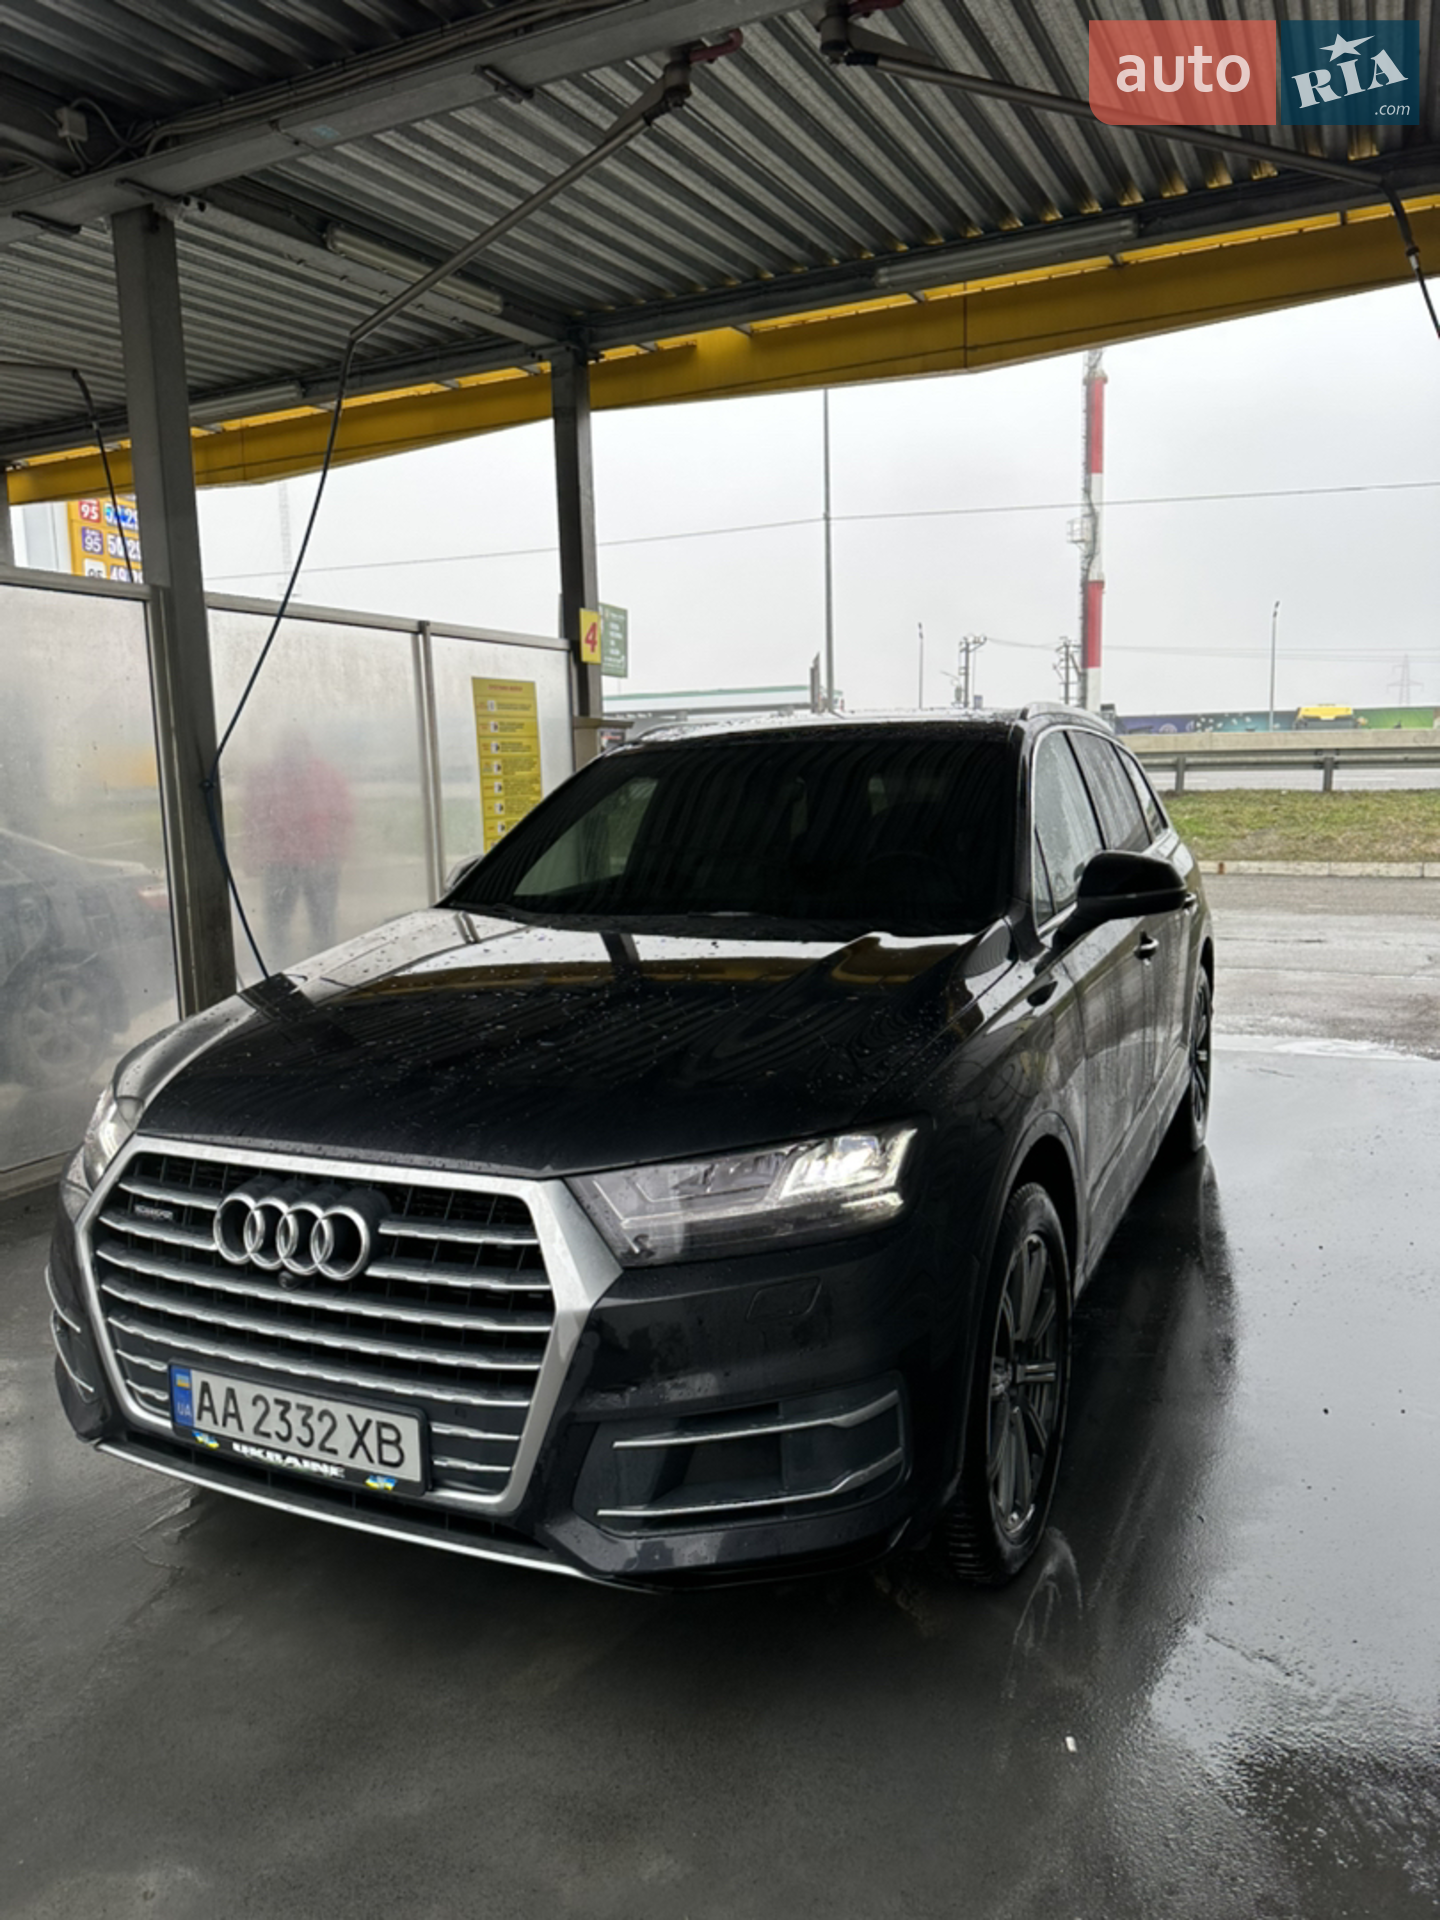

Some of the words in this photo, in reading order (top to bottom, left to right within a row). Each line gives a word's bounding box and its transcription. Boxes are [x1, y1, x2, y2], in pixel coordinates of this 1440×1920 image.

[81, 504, 99, 521] 95
[84, 536, 102, 552] 95
[584, 622, 598, 654] 4
